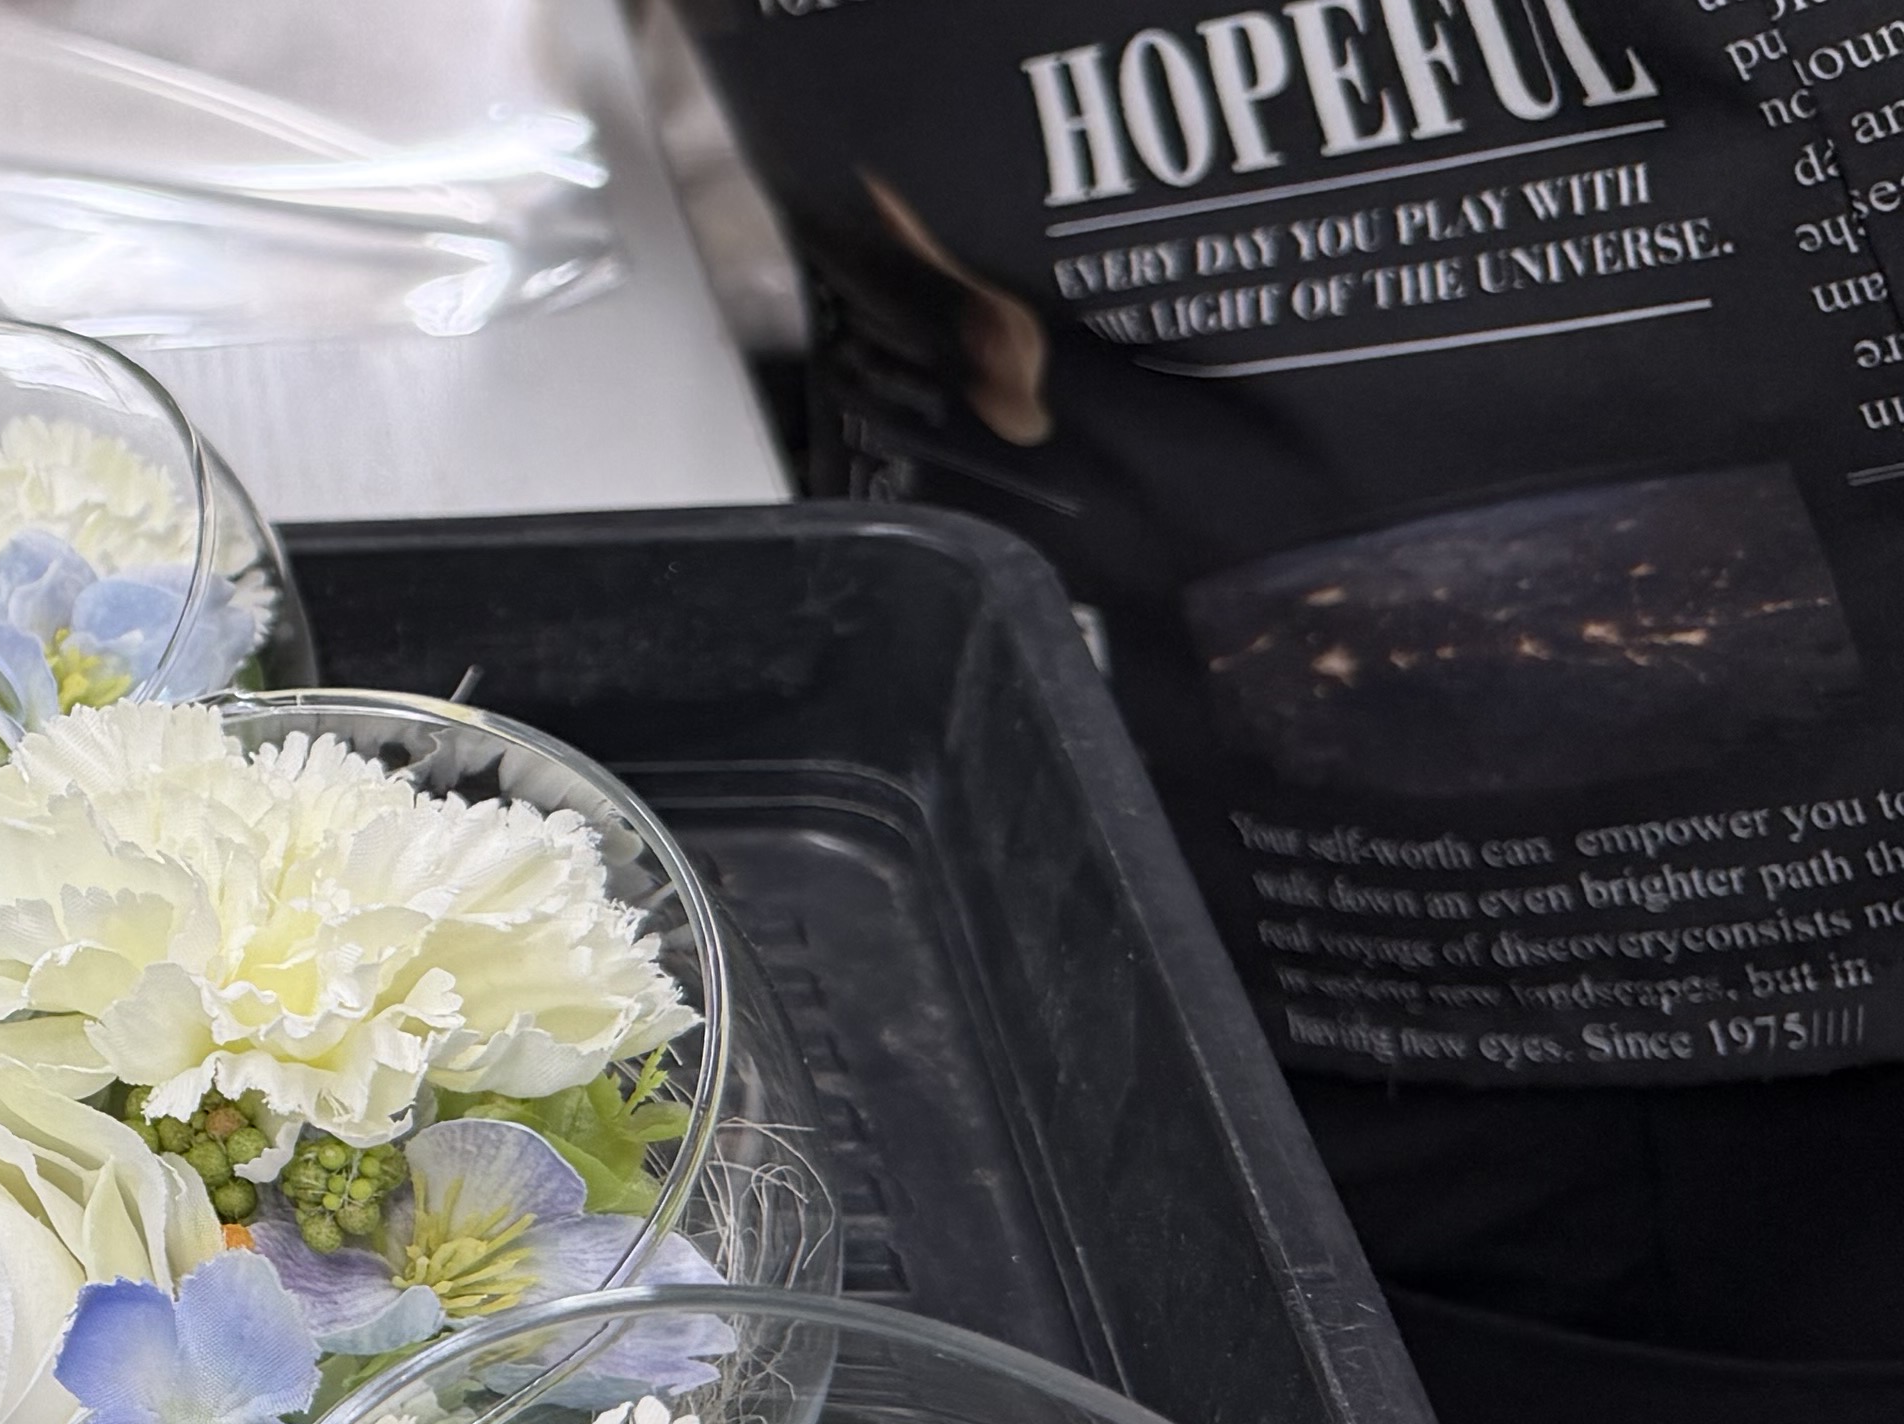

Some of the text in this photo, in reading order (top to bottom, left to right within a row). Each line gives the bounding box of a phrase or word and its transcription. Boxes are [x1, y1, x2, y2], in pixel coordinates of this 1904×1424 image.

[1052, 162, 1654, 302] EVERY DAY YOU PLAY WITH
[1794, 213, 1866, 254] he
[1150, 282, 1286, 343] LIGHT
[1291, 270, 1358, 323] OF
[1364, 256, 1464, 313] THE
[1476, 216, 1736, 296] UNIVERSE.
[1811, 271, 1889, 314] am
[1481, 835, 1555, 868] can
[1575, 807, 1771, 860] empower
[1781, 796, 1868, 844] you
[1328, 875, 1424, 920] down
[1424, 889, 1473, 920] an
[1478, 882, 1575, 919] even
[1579, 862, 1747, 914] brighter
[1758, 848, 1855, 902] path
[1442, 930, 1483, 967] of
[1744, 961, 1820, 1000] but
[1827, 951, 1876, 989] in
[1477, 1031, 1576, 1070] eyes.
[1580, 1021, 1694, 1063] Since
